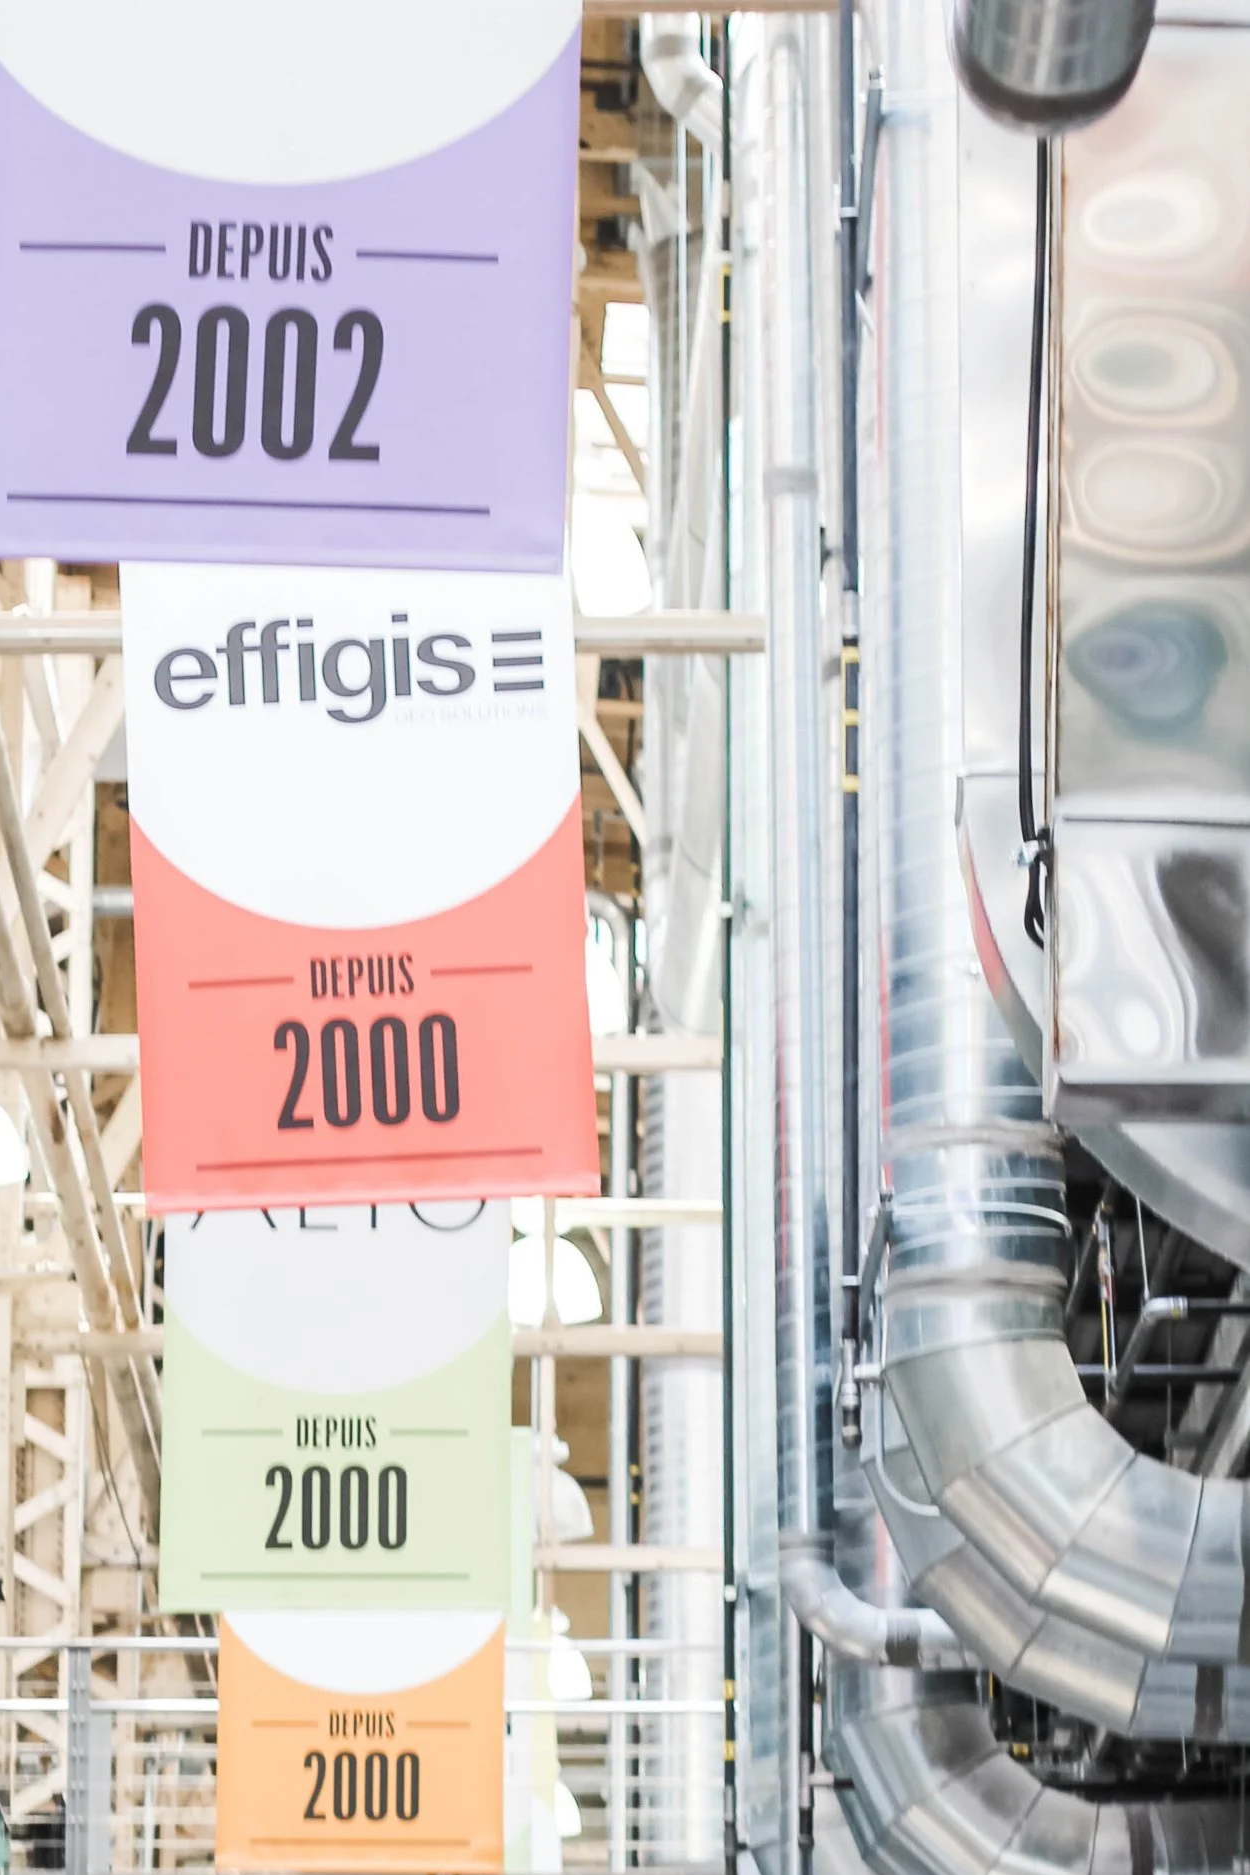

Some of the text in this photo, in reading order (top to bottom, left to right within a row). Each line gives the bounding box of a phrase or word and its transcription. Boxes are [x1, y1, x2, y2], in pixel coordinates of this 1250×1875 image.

[188, 221, 334, 282] DEPUIS
[126, 303, 384, 462] 2002
[310, 953, 415, 1000] DEPUIS
[273, 1013, 460, 1131] 2000
[296, 1417, 377, 1448] DEPUIS
[264, 1465, 408, 1551] 2000
[329, 1711, 395, 1738] DEPUIS
[303, 1750, 420, 1822] 2000
